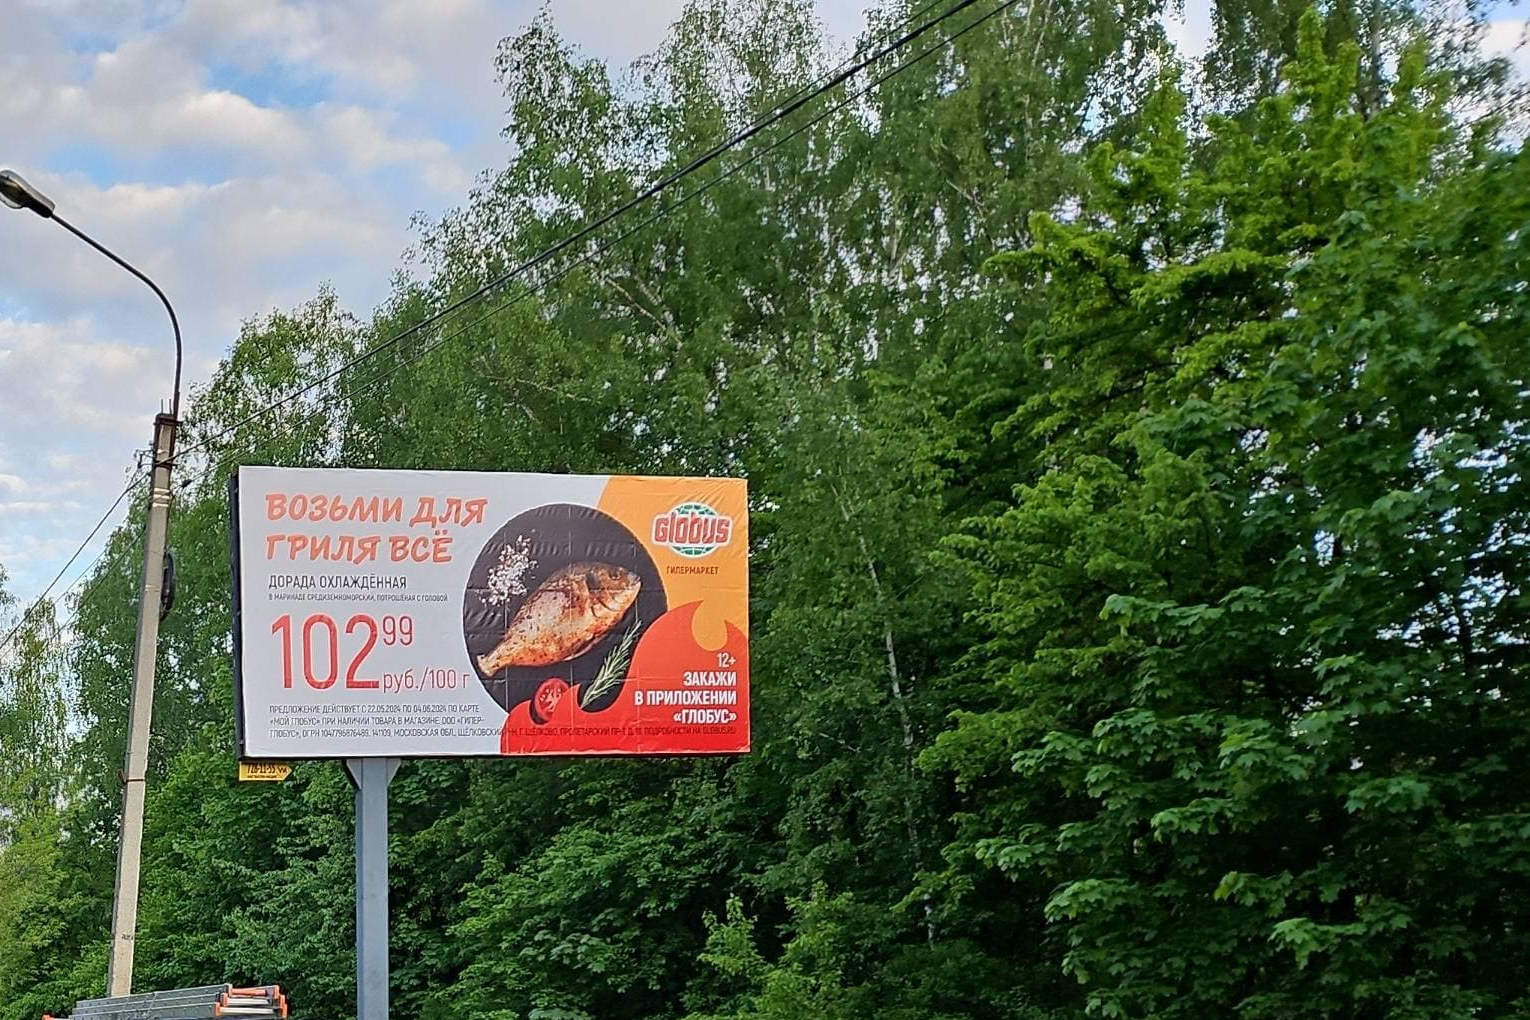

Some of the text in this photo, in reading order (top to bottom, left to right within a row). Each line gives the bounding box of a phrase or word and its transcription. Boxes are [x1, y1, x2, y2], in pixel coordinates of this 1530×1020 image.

[266, 493, 488, 528] ВОЗЬМИ ДЛЯ
[266, 529, 453, 564] ГРИЛЯ ВСЁ
[666, 566, 719, 575] ГИПЕРМАРКЕТ
[269, 573, 407, 590] ДОРАДА ОХЛАЖДЁННАЯ
[274, 593, 305, 601] МАРИНАДЕ
[272, 614, 413, 690] 102 99
[717, 653, 736, 668] 12+
[383, 666, 470, 694] руб./100 г
[683, 672, 737, 686] ЗАКАЖИ
[634, 690, 737, 706] В ПРИЛОЖЕНИИ
[270, 705, 320, 714] ПРЕДЛОЖЕНИЕ
[322, 703, 360, 714] ДЕЙСТВУЕТ
[402, 704, 412, 713] ПО
[448, 704, 457, 713] ПО
[459, 704, 480, 713] КАРТЕ
[322, 717, 336, 725] ПРИ
[338, 717, 370, 726] НАЛИЧИИ
[371, 717, 396, 725] ТОВАРА
[441, 717, 455, 725] ООО
[673, 709, 737, 724] «ГЛОБУС»
[302, 729, 320, 738] ОГРН
[394, 728, 439, 737] МОСКОВСКАЯ
